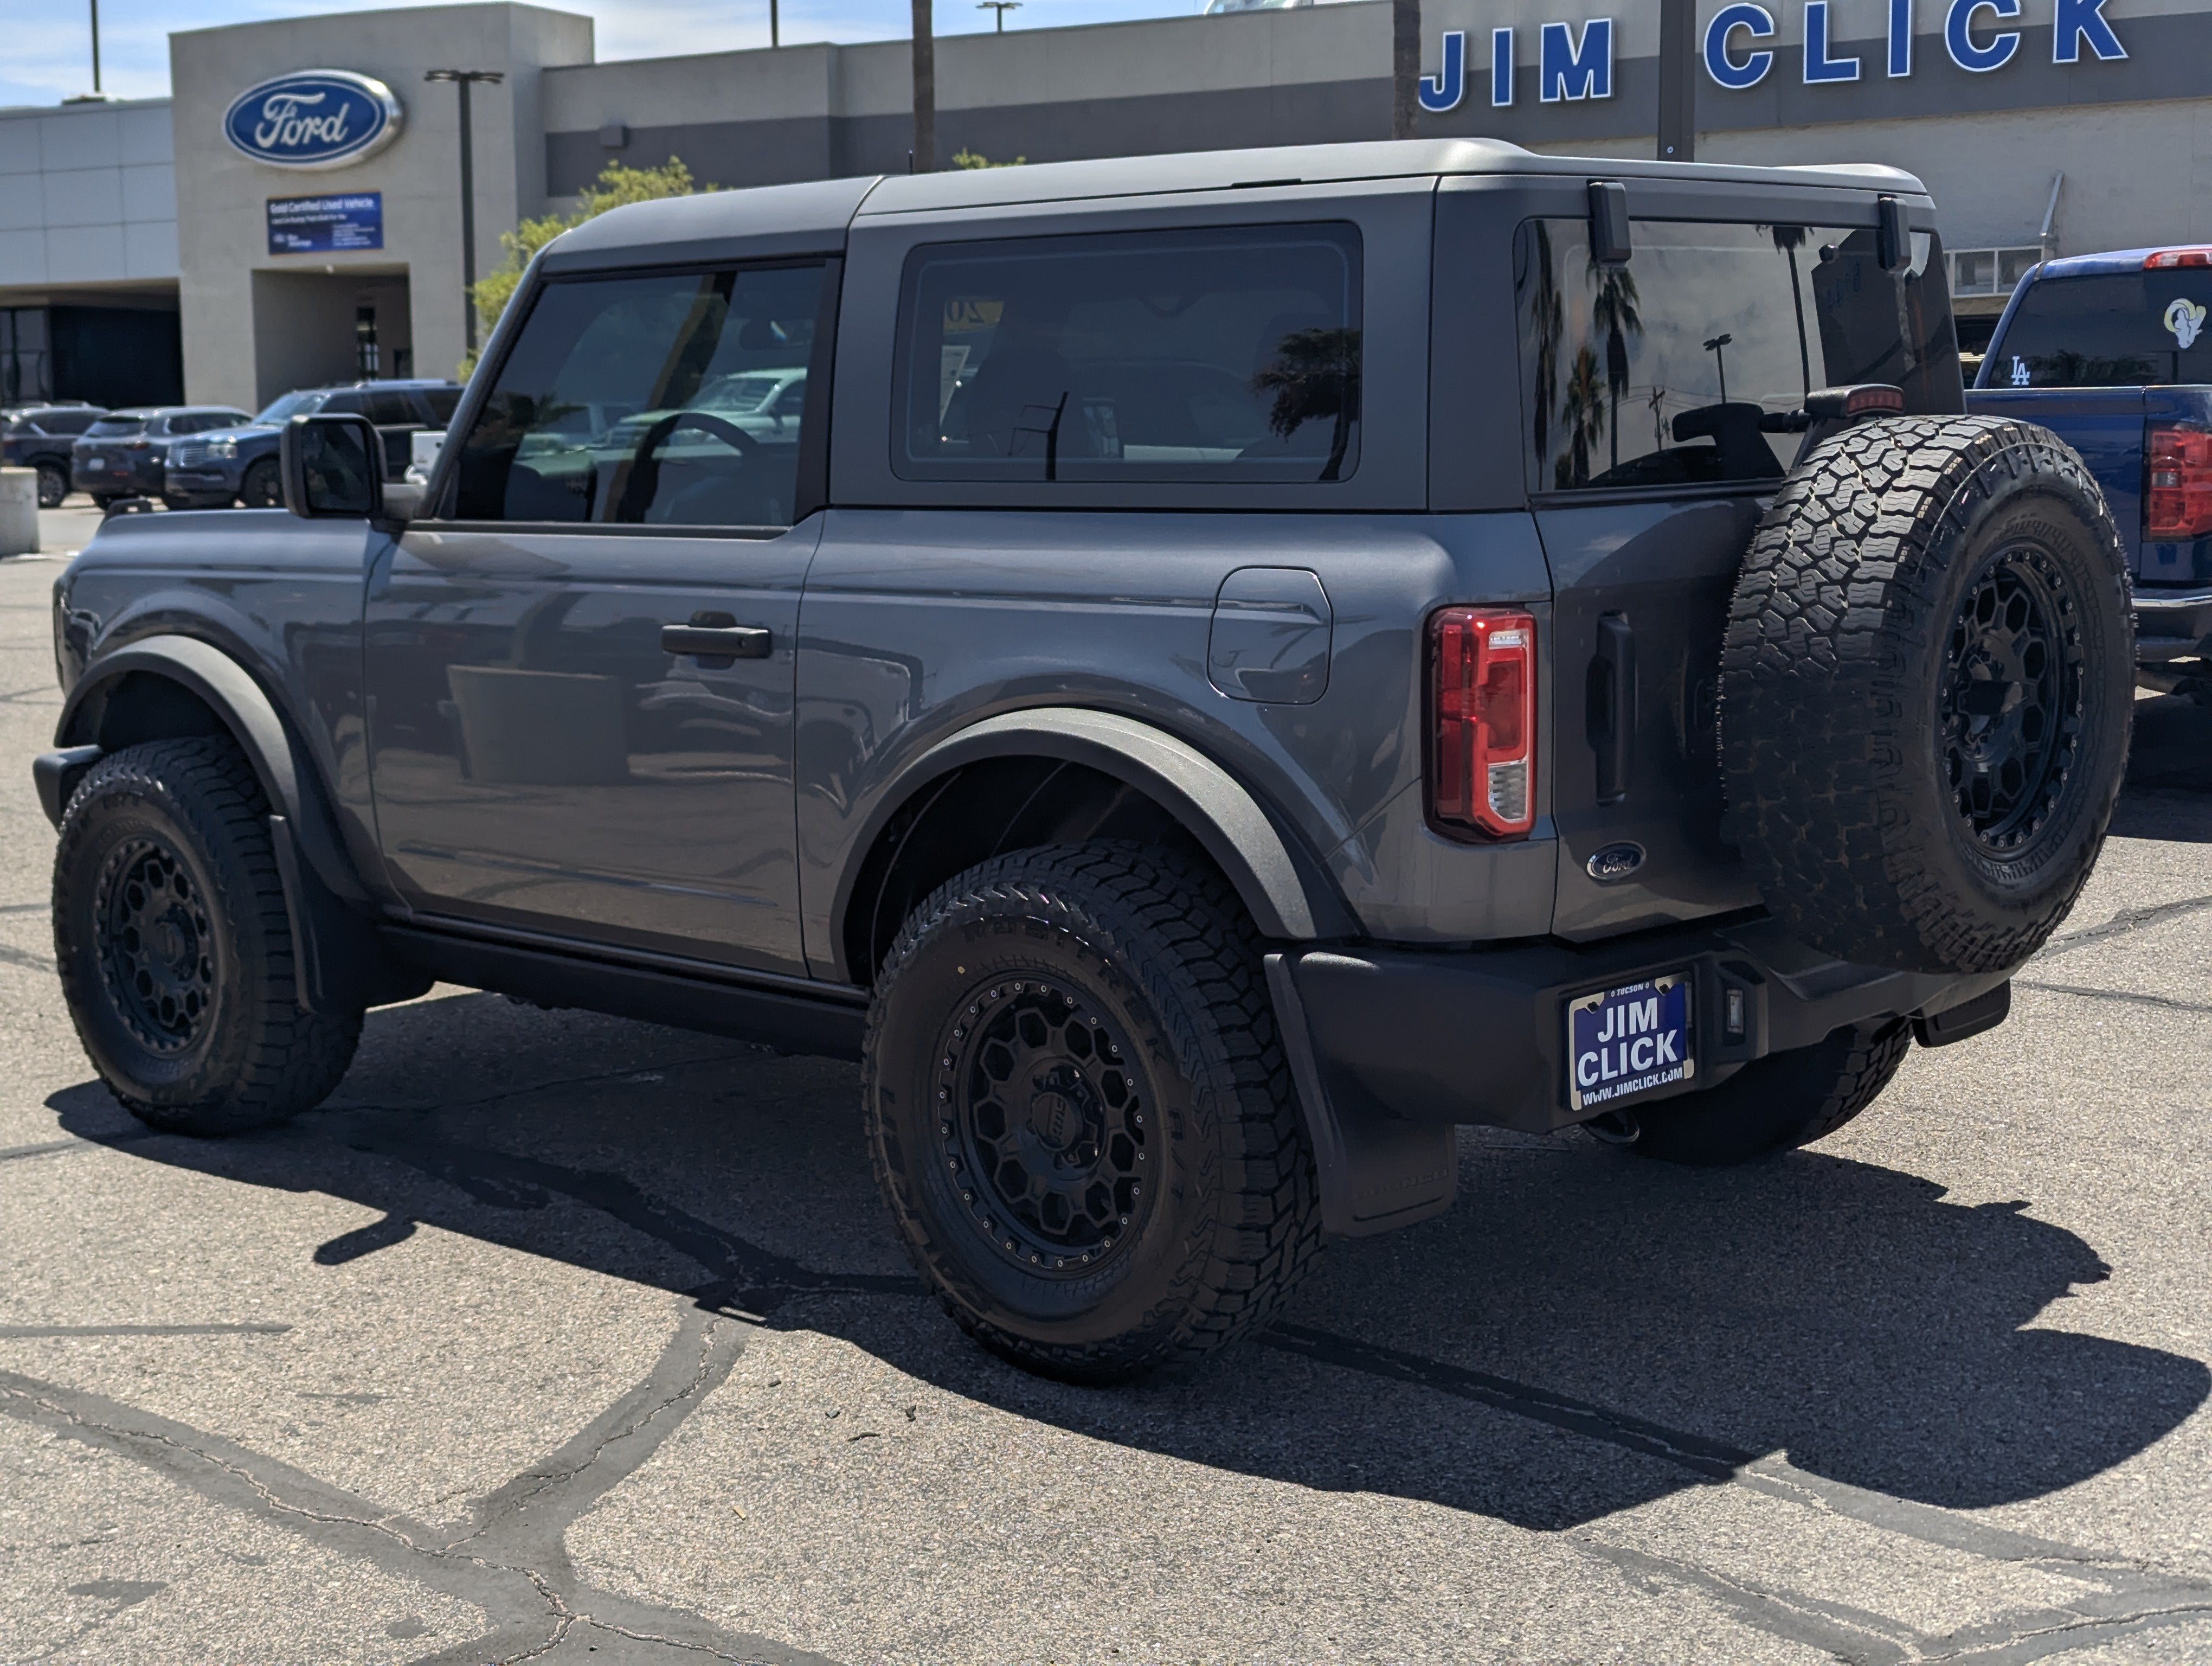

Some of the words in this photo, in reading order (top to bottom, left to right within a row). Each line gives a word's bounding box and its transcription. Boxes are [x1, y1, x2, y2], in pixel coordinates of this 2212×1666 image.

[1418, 17, 1612, 112] JIM
[1703, 0, 2129, 89] CLICK
[254, 91, 350, 149] Ford
[2011, 356, 2030, 385] LA
[1603, 853, 1634, 873] Ford
[1617, 983, 1643, 996] TUCSON
[1597, 997, 1657, 1042] JIM
[1578, 1029, 1678, 1087] CLICK
[1583, 1067, 1683, 1106] WWW.JIMCLICK.COM
